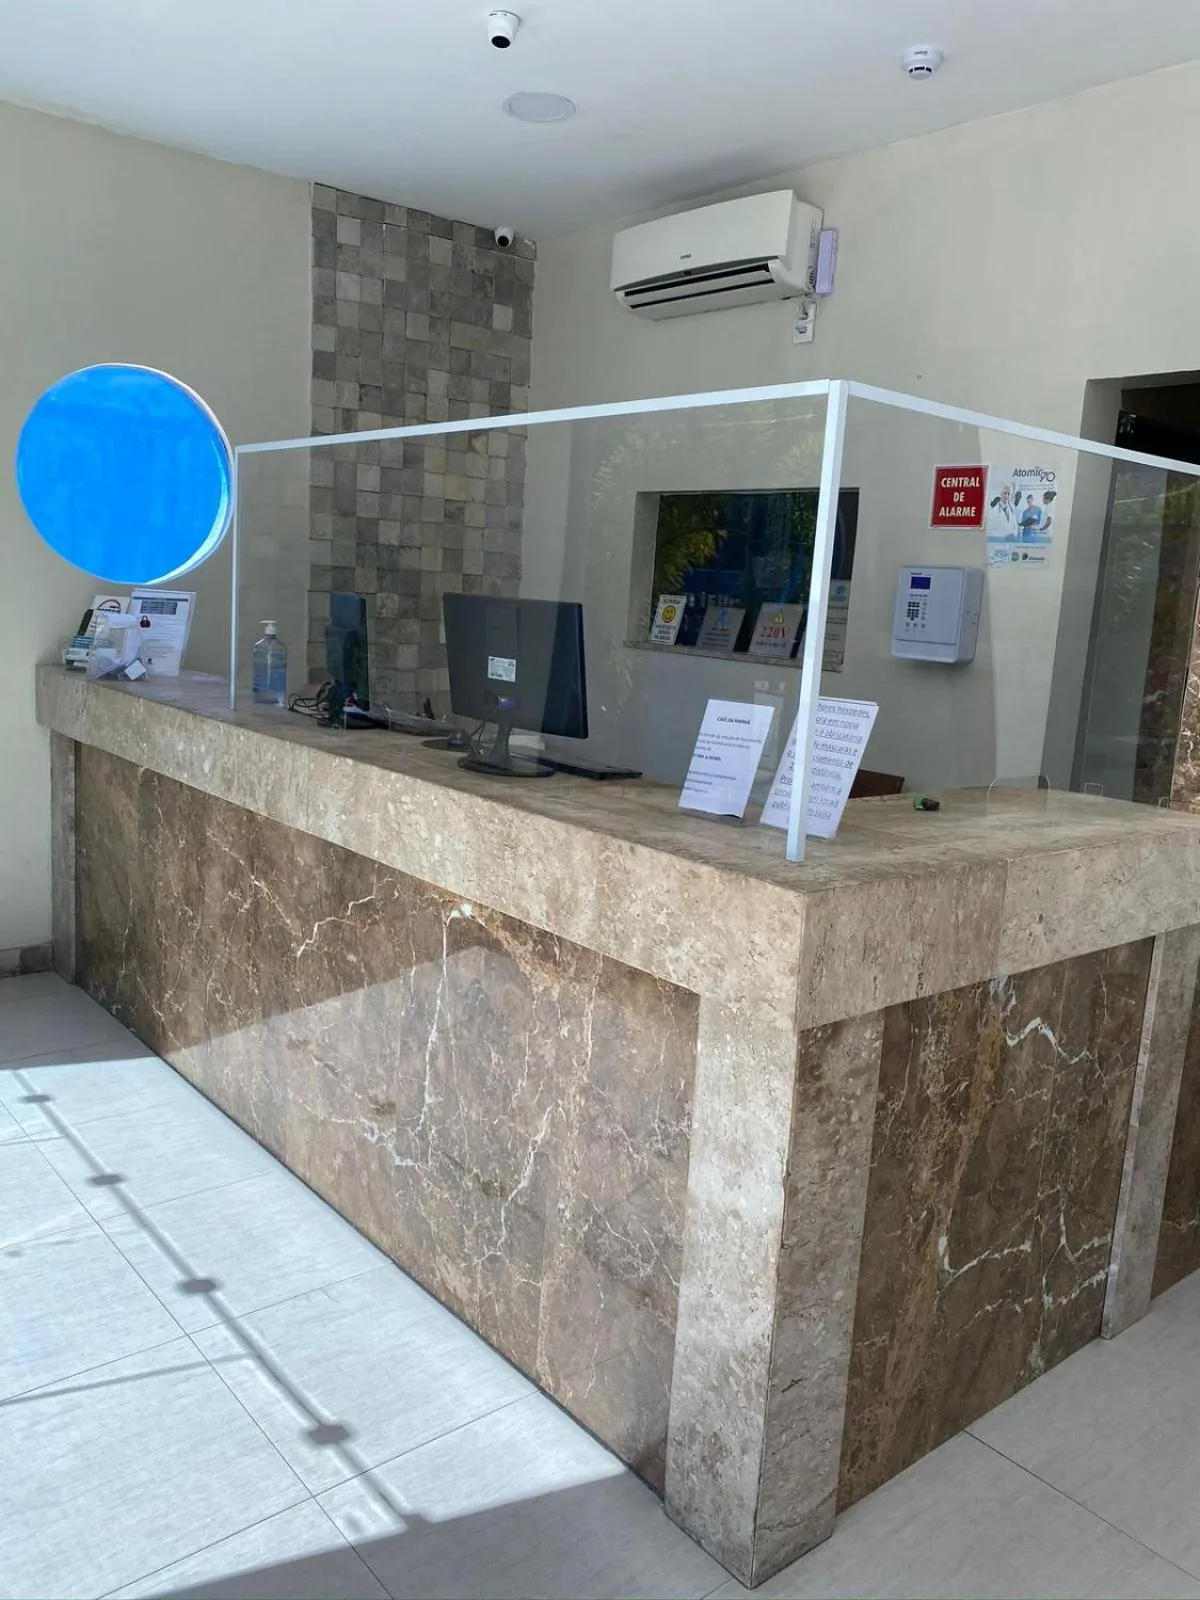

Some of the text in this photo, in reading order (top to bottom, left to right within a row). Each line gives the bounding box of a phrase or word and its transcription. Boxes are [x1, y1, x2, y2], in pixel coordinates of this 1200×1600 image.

[941, 476, 980, 488] CENTRAL
[953, 491, 965, 502] DE
[938, 506, 977, 517] ALARME
[760, 626, 787, 639] 220V
